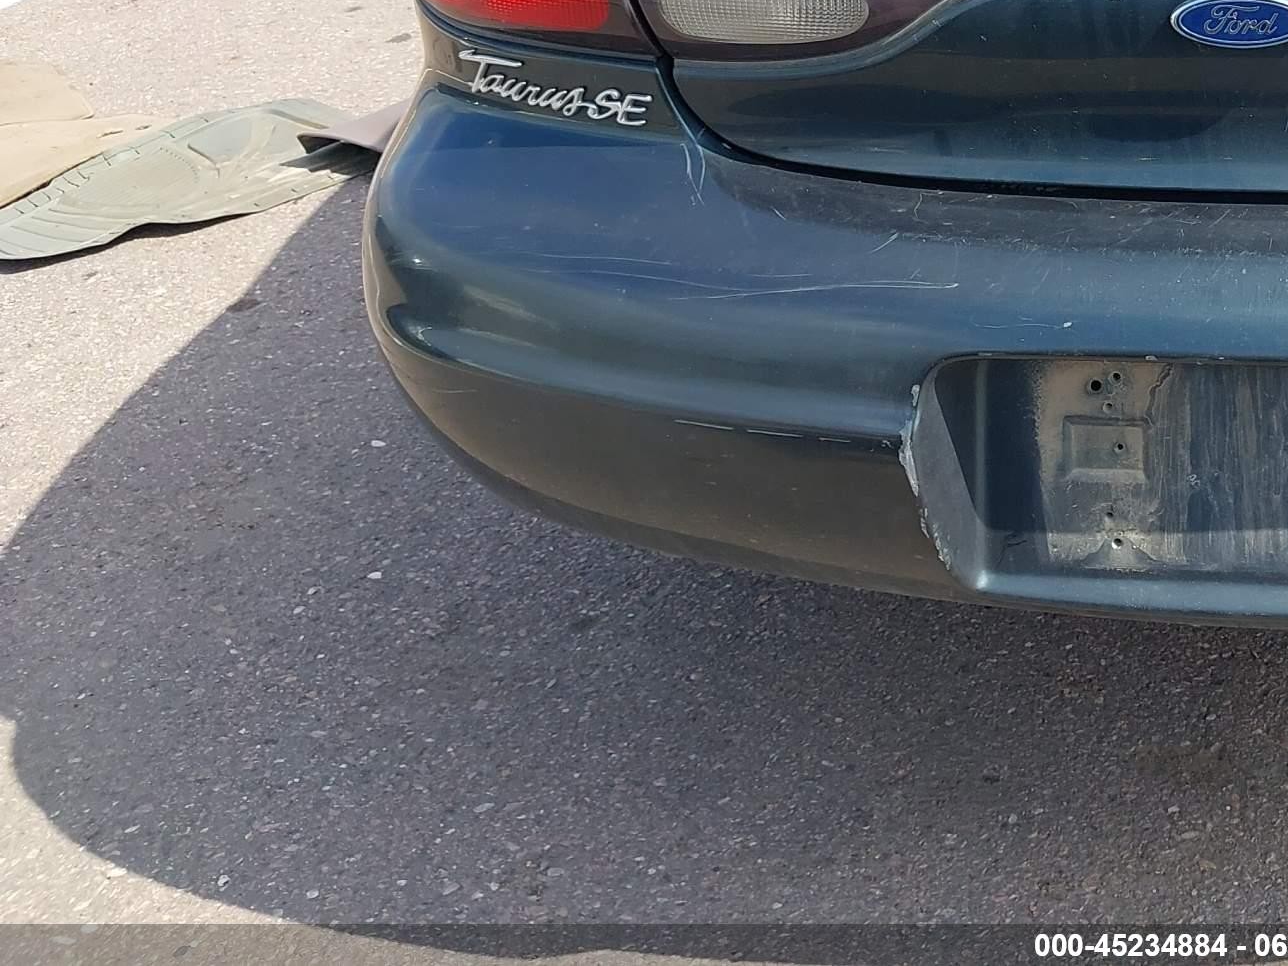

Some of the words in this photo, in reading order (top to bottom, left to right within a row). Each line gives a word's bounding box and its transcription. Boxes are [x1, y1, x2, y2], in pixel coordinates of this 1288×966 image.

[1203, 4, 1280, 35] Ford
[458, 49, 585, 117] Taurus
[587, 88, 652, 126] SE
